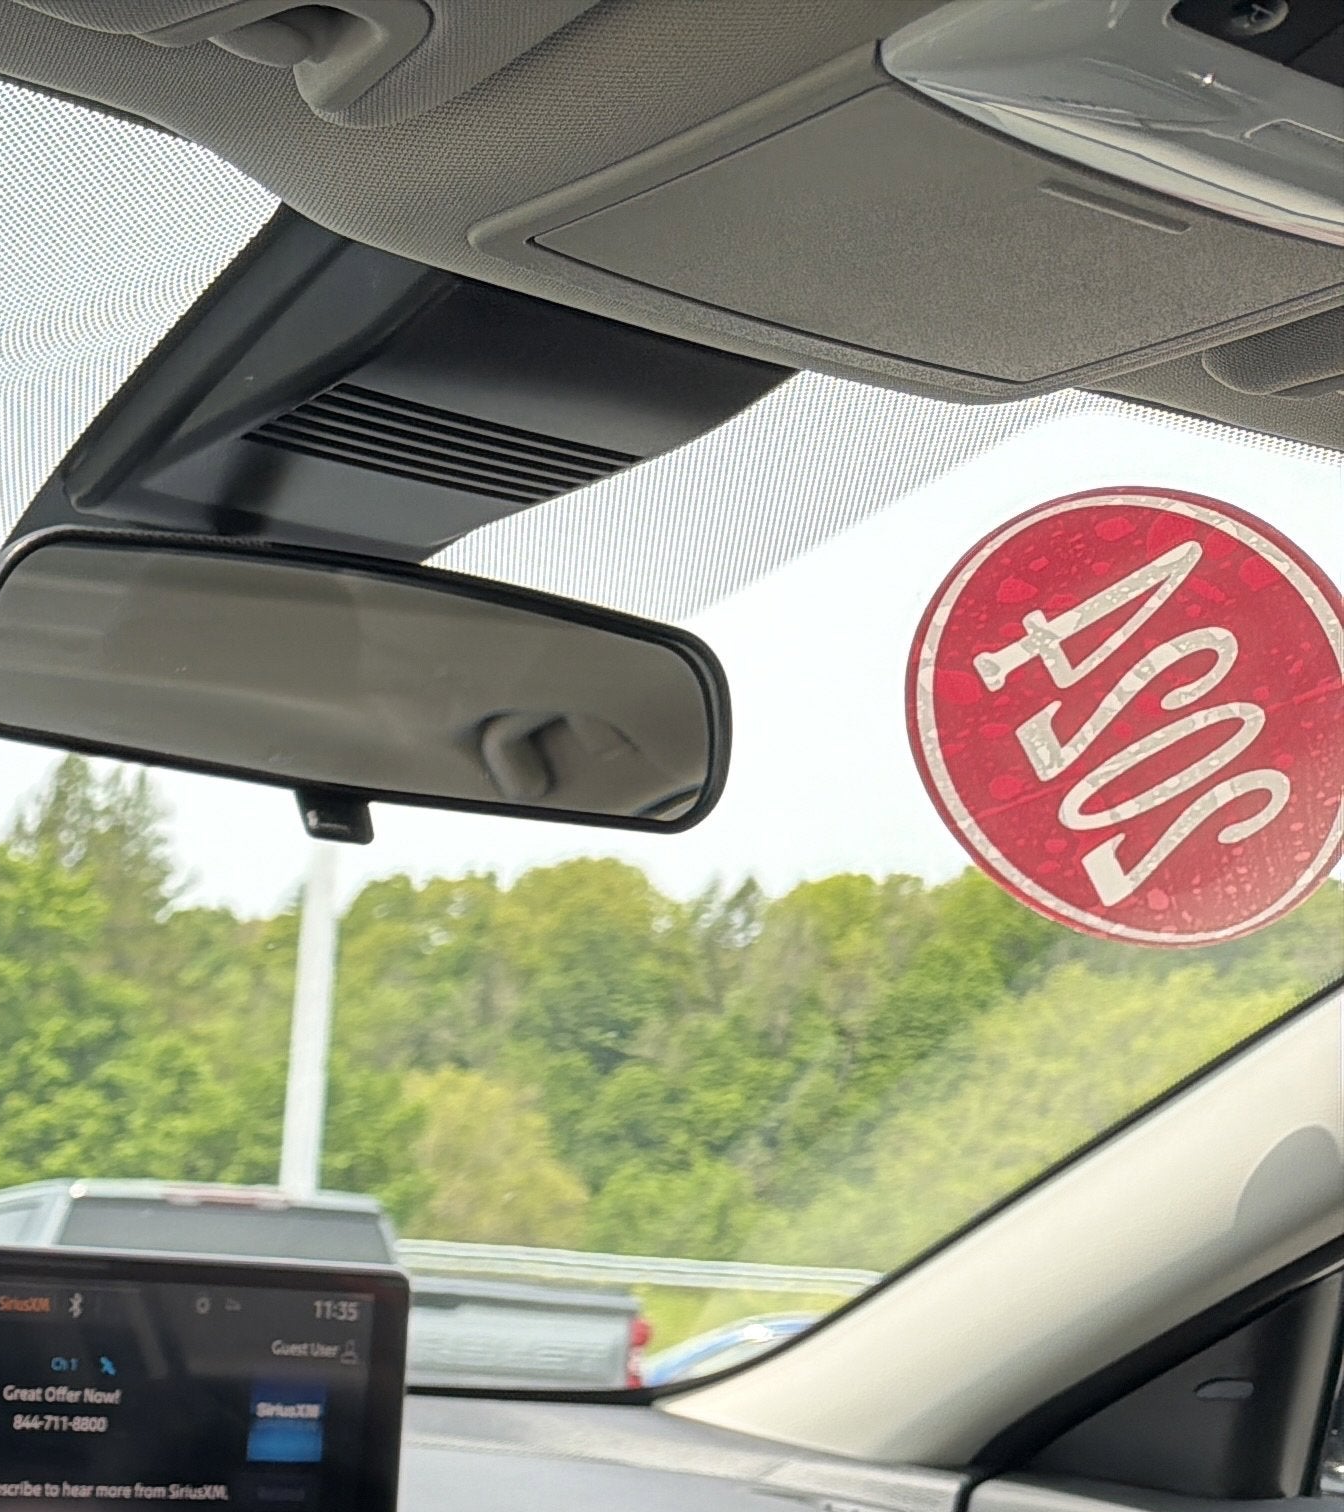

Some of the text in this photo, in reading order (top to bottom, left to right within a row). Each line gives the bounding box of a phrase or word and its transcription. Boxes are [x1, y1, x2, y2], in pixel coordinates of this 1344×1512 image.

[313, 1300, 359, 1322] 11:35
[271, 1339, 341, 1359] Guest User
[2, 1385, 122, 1404] Great Offer Now!
[13, 1414, 108, 1432] 844-711-8800
[44, 1483, 60, 1498] to
[62, 1482, 94, 1498] hear
[96, 1485, 132, 1499] more
[134, 1483, 167, 1499] from
